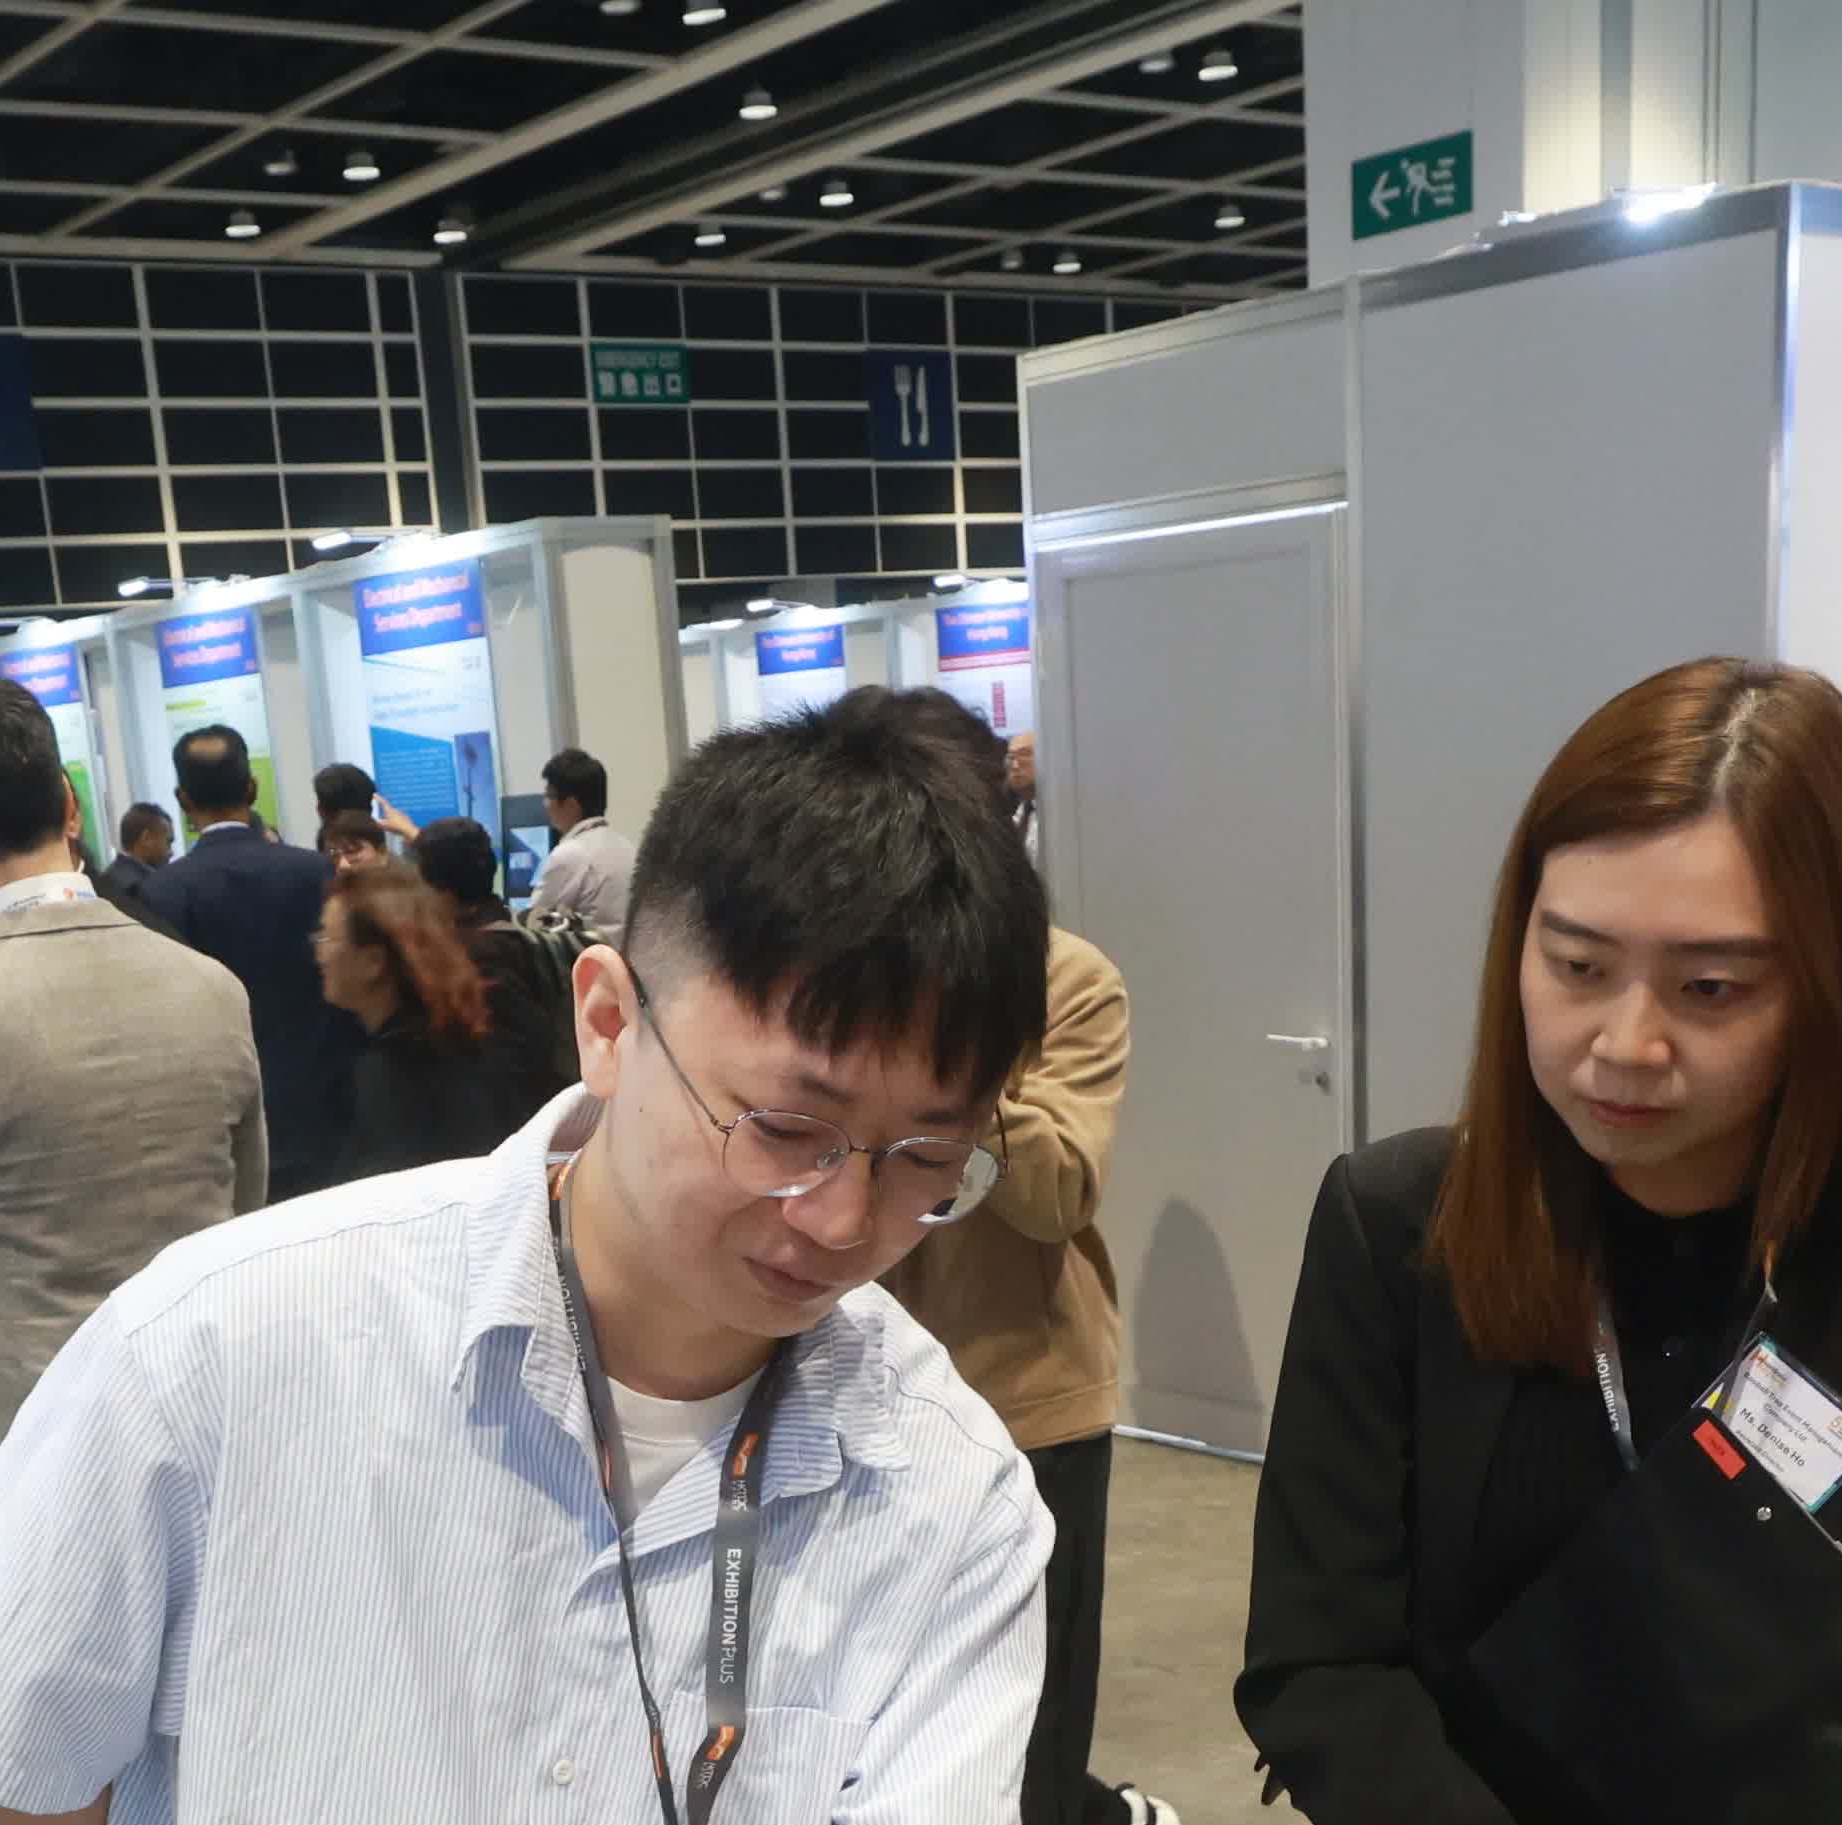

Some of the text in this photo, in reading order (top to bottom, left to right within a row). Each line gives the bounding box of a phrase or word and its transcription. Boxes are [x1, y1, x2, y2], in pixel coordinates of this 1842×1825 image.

[1739, 1407, 1807, 1468] Ms. Denise Ho
